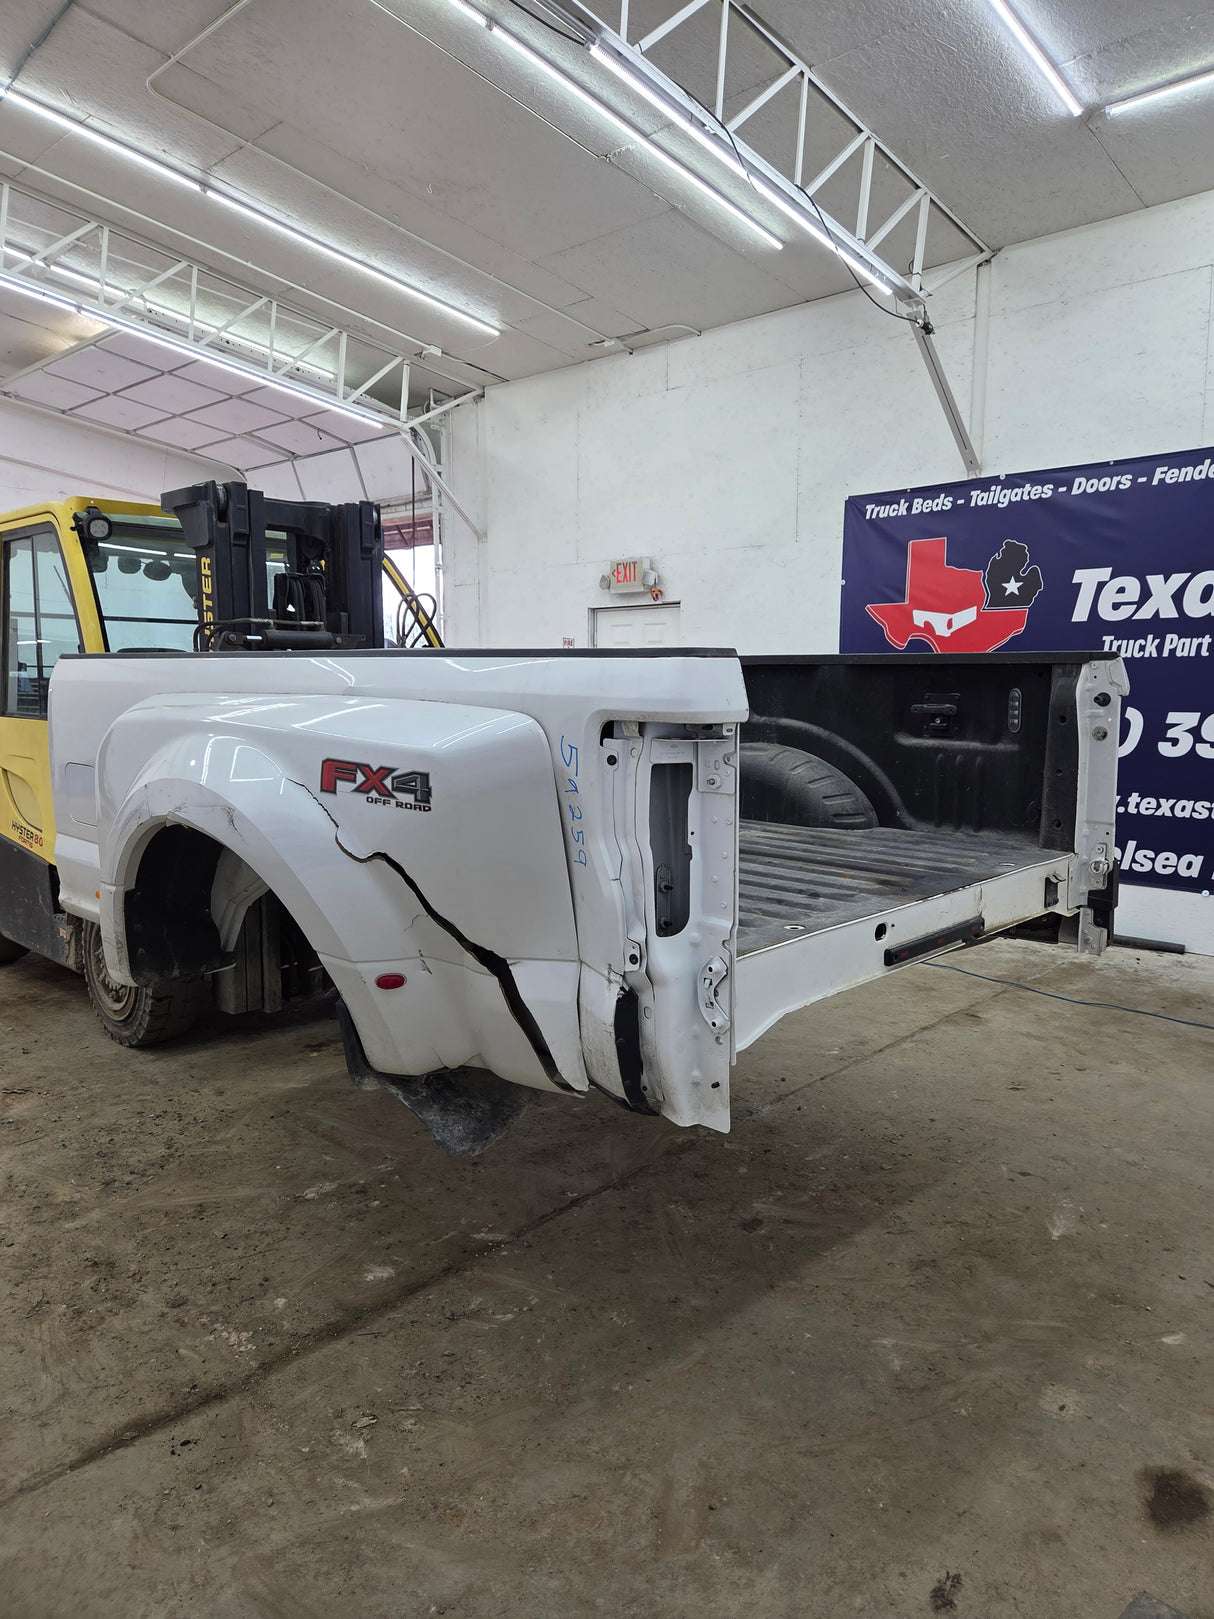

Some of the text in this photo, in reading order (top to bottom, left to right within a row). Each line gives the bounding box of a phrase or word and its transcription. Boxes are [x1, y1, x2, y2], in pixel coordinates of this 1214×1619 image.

[865, 499, 908, 520] Truck
[911, 494, 954, 515] Beds
[970, 484, 1054, 507] Tailgates
[1071, 474, 1133, 496] Doors
[616, 561, 638, 584] EXIT
[200, 556, 214, 652] STER
[1071, 567, 1214, 622] Texa
[1102, 633, 1212, 658] Truck Part
[320, 758, 432, 805] FX4
[366, 796, 432, 813] OFF ROAD
[1116, 792, 1214, 820] .texas
